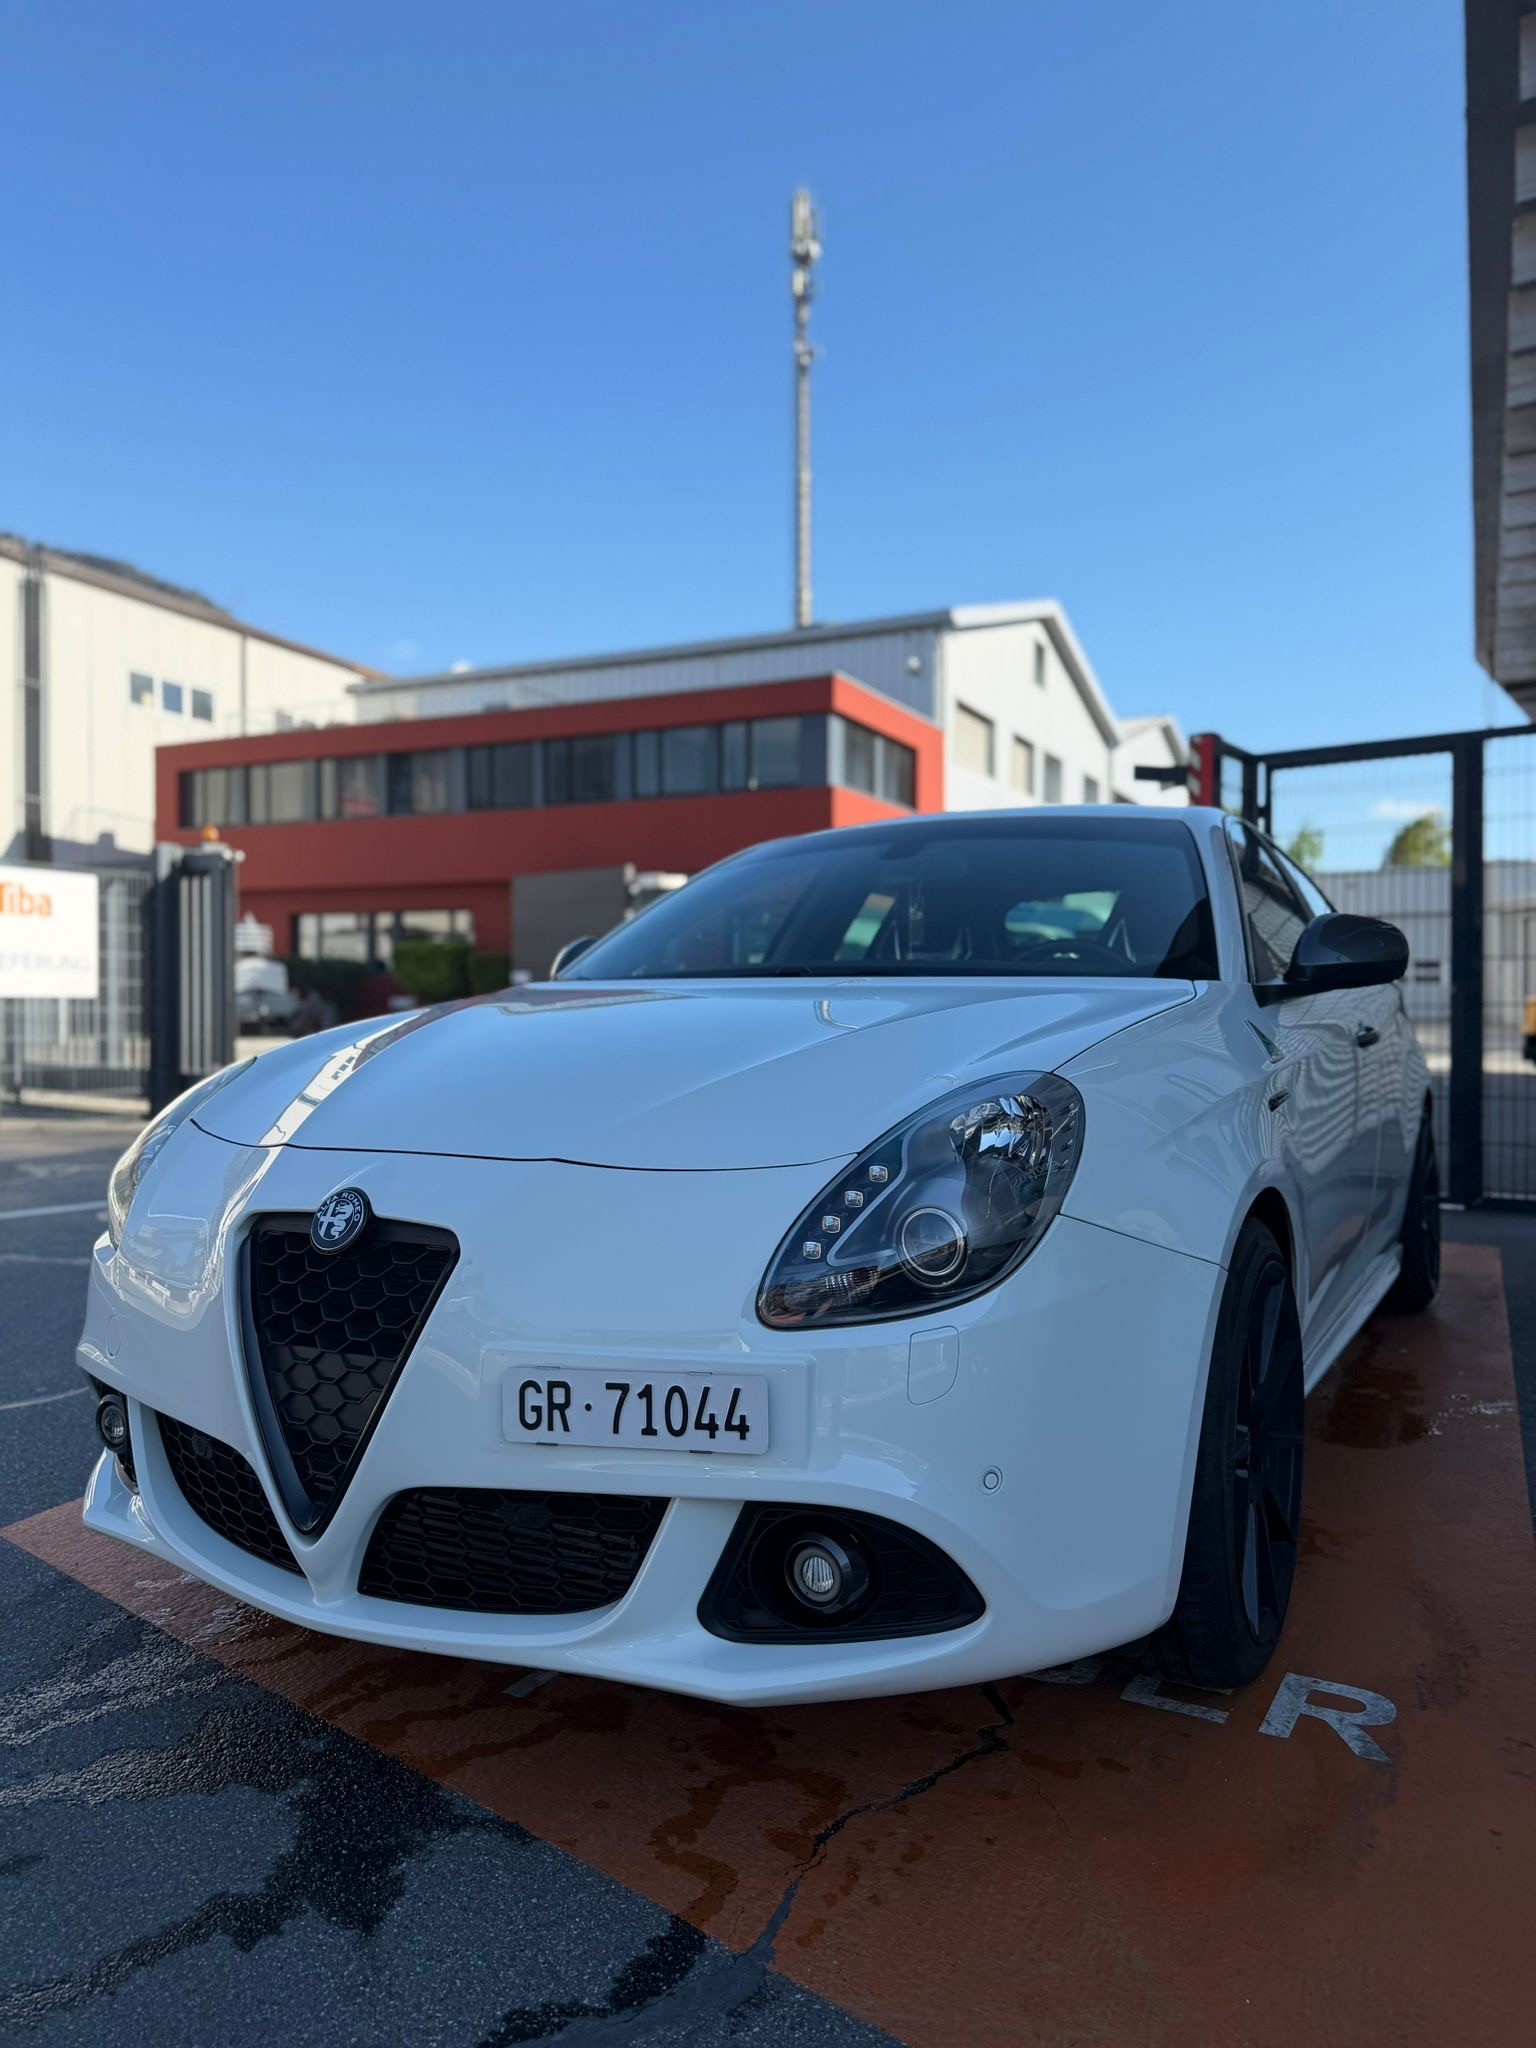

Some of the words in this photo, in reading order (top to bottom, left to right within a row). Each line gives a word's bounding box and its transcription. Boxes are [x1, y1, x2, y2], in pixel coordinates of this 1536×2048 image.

[316, 1195, 339, 1219] ALFA
[341, 1192, 361, 1221] ROMEO
[518, 1379, 571, 1432] GR
[605, 1382, 750, 1440] 71044
